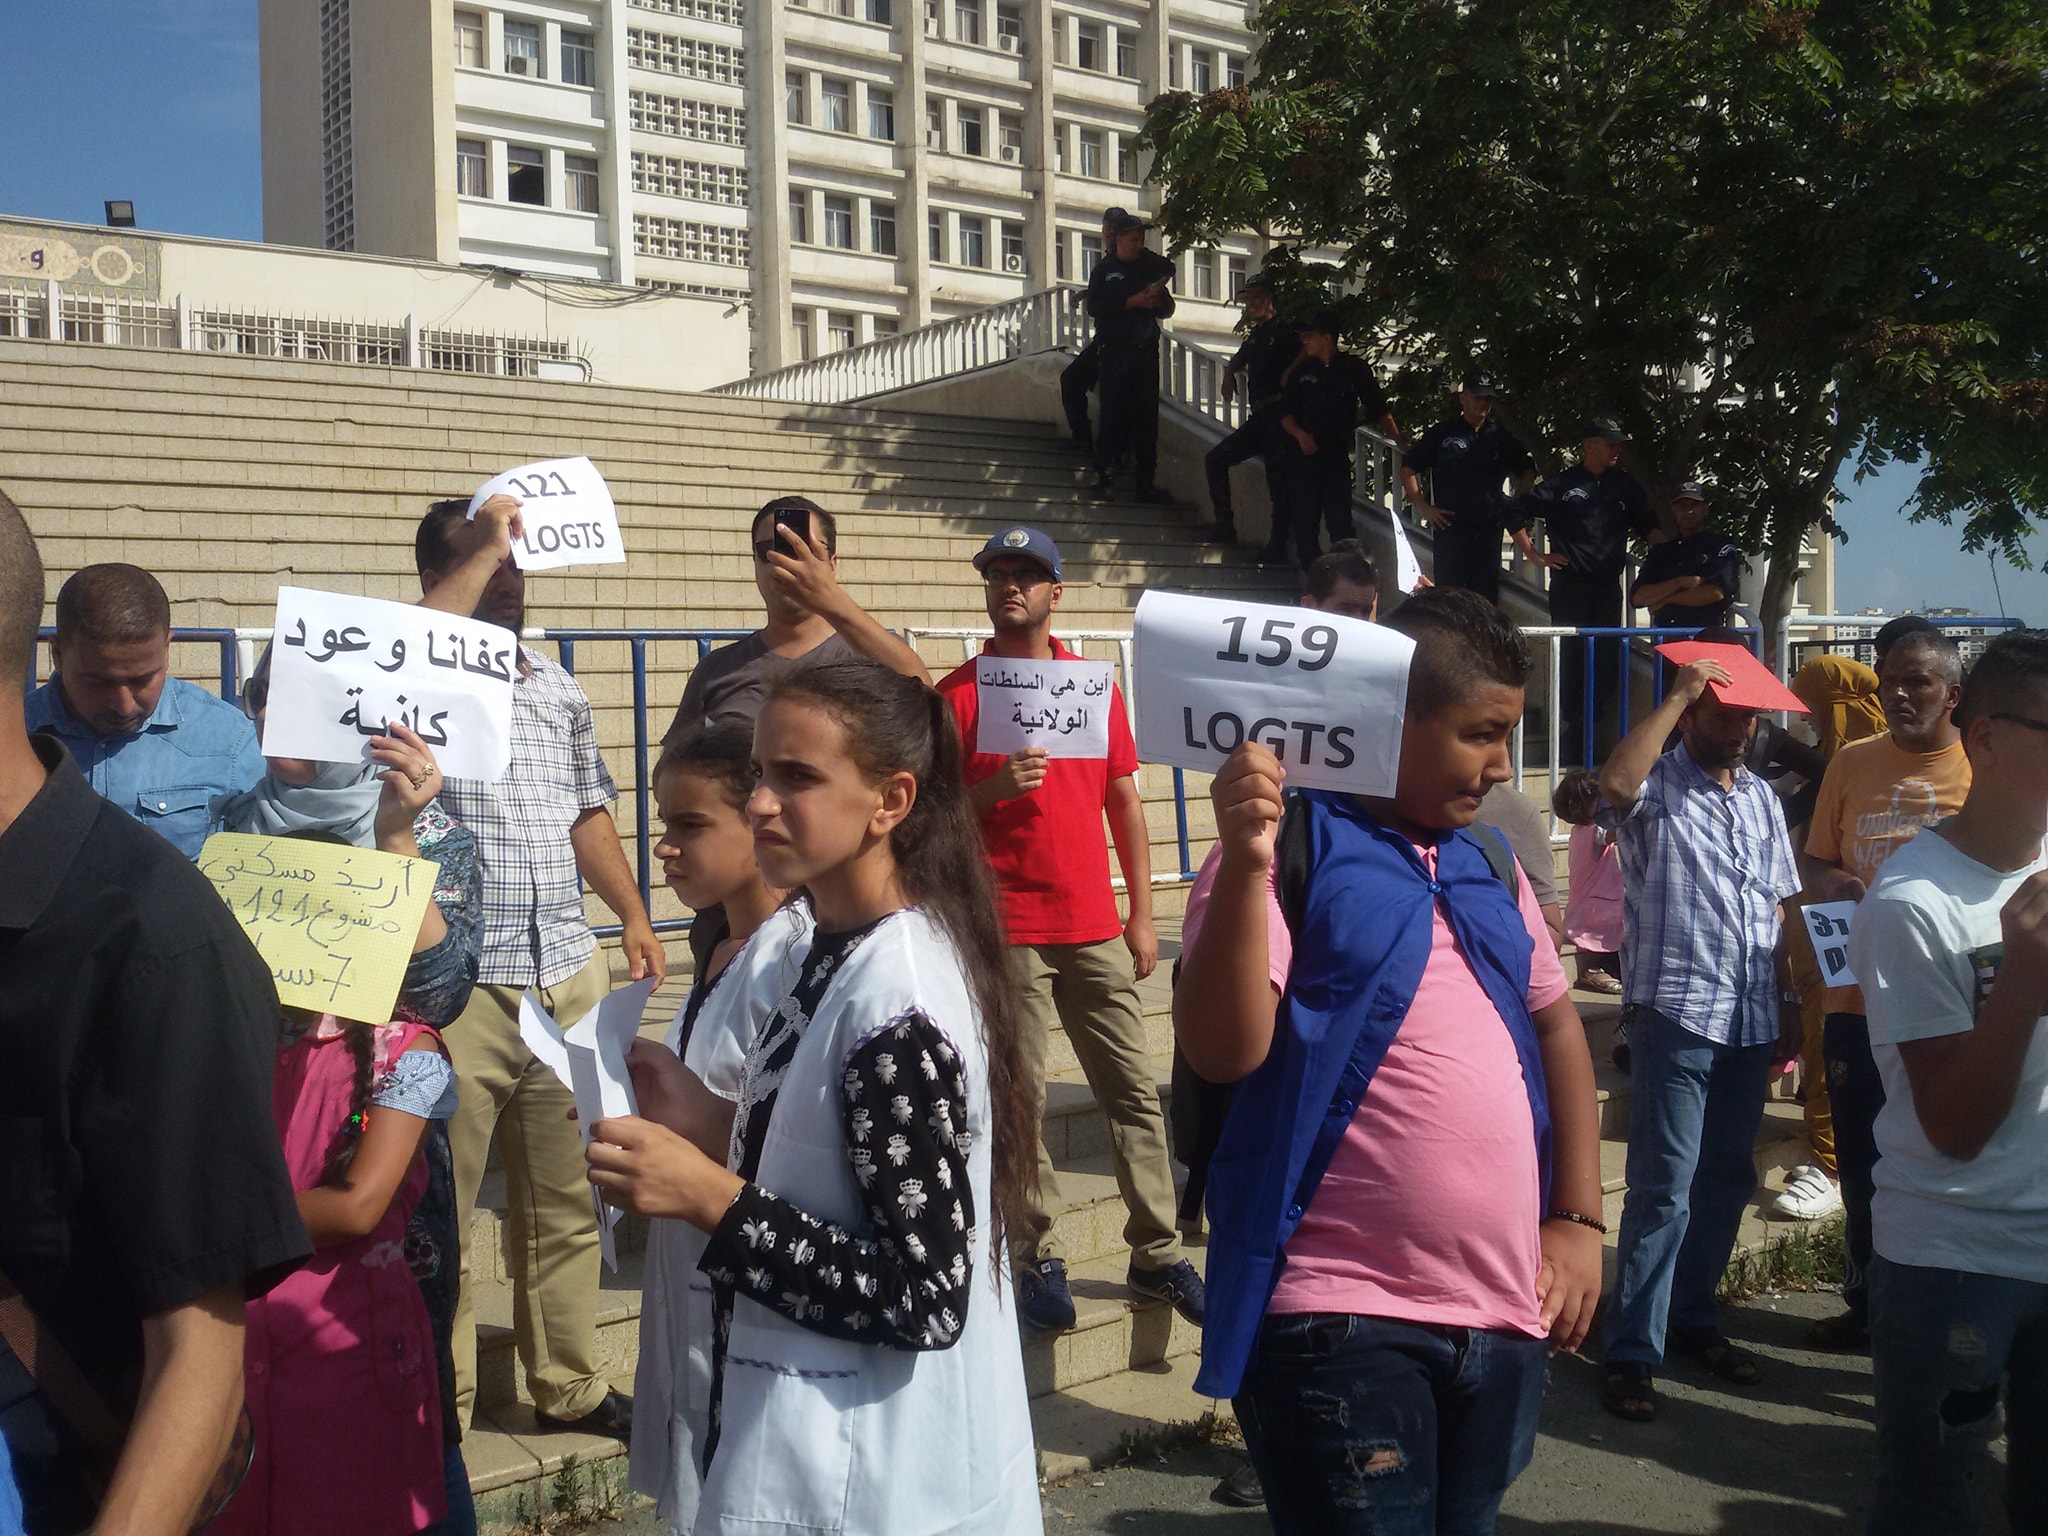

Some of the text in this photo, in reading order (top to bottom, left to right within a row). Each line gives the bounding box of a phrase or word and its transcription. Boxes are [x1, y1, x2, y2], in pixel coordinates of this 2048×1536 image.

[508, 471, 577, 498] 121
[522, 521, 606, 555] LOGTS
[426, 629, 511, 683] كفانا
[1216, 615, 1339, 672] 159
[979, 670, 1109, 700] أين هي السلطات
[1011, 701, 1089, 736] الولائية
[1183, 706, 1355, 769] LOGTS
[201, 840, 316, 889] مسكني
[243, 886, 310, 927] 121
[322, 953, 352, 1002] 7
[1824, 944, 1848, 977] D
